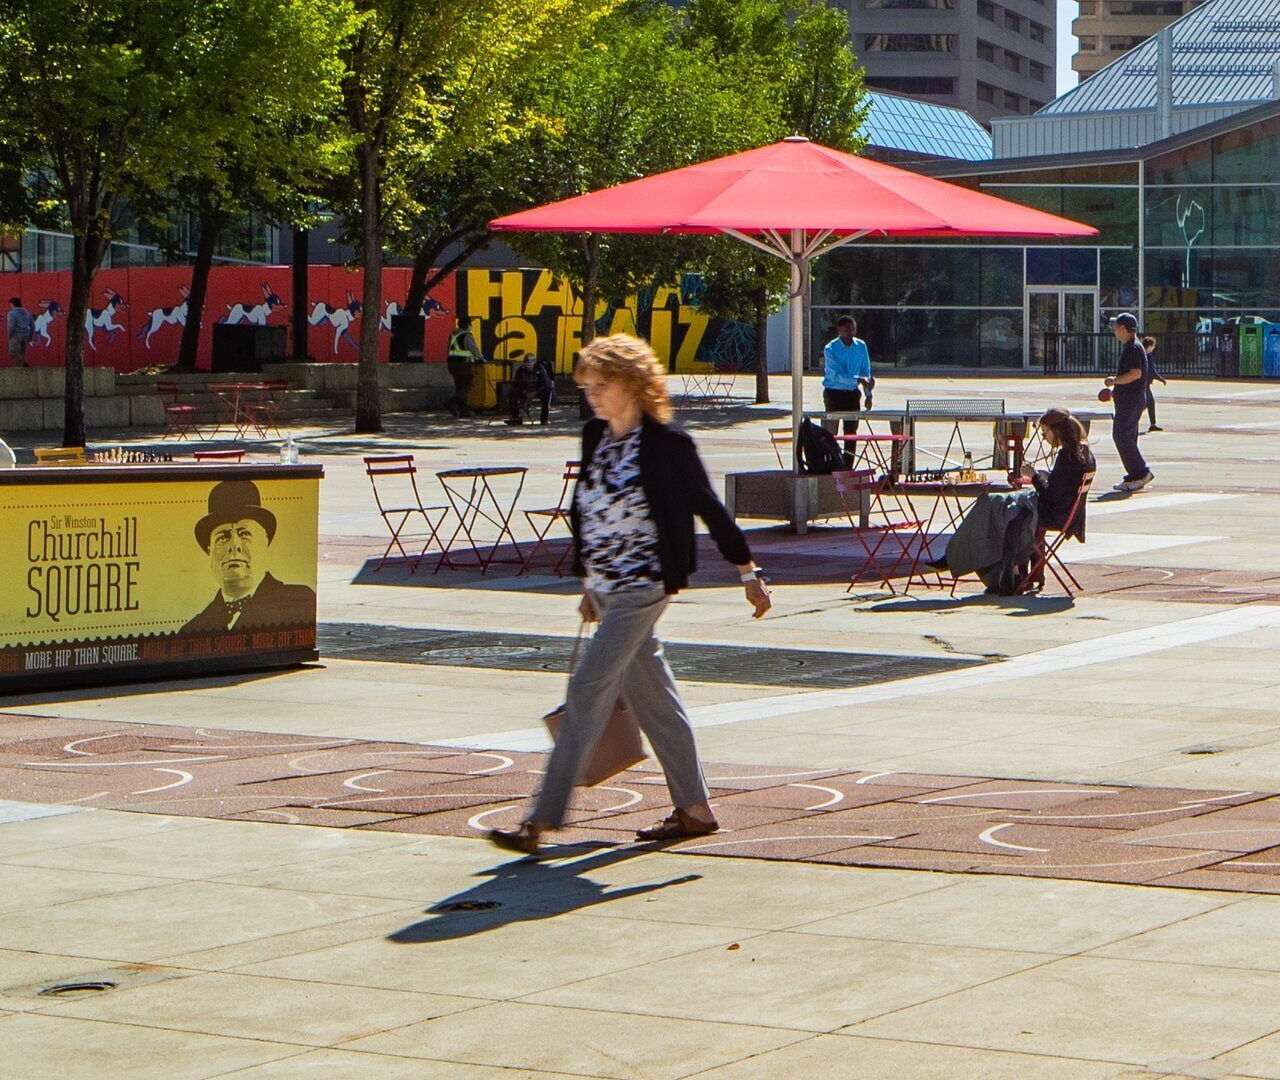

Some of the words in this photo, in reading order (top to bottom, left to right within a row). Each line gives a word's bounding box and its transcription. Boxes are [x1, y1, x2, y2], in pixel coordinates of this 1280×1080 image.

[27, 517, 138, 562] Churchill
[50, 515, 62, 529] Sir
[64, 514, 97, 529] Winston
[26, 562, 140, 622] SQUARE
[25, 650, 52, 670] MORE
[55, 649, 72, 667] HIP
[74, 646, 100, 666] THAN
[102, 643, 141, 664] SQUARE.
